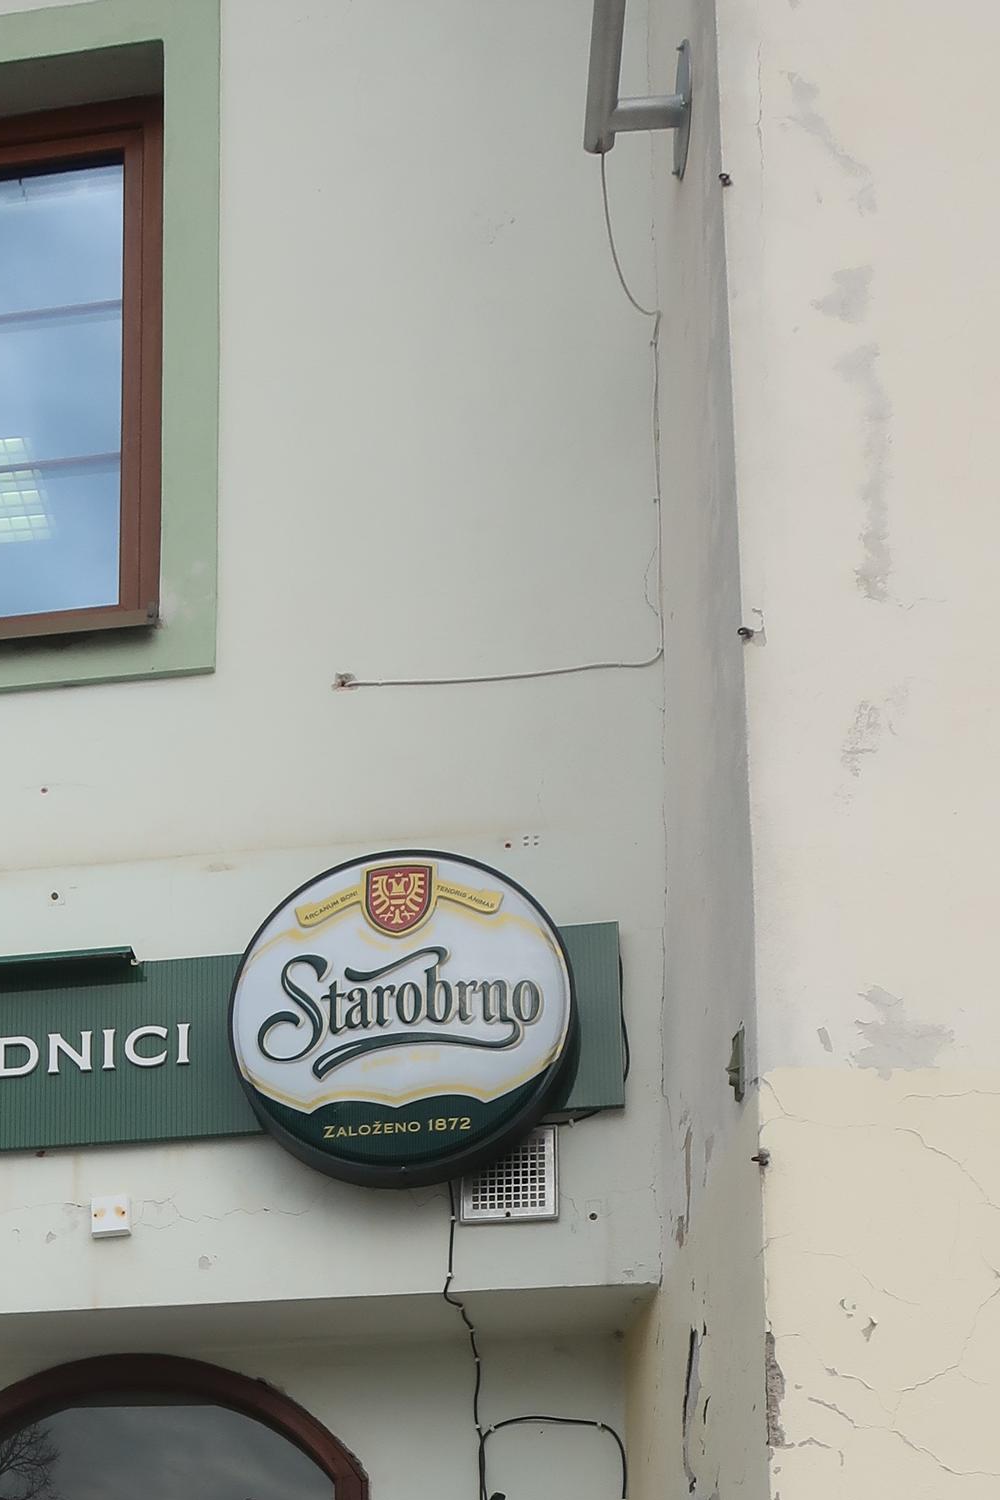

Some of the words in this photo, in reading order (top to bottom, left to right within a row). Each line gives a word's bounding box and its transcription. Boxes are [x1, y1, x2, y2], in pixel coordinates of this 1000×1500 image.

[304, 899, 339, 921] ARCANUM
[340, 890, 359, 903] BONI
[257, 945, 544, 1081] Starobrno
[323, 1120, 421, 1139] ZALOŽENO
[428, 1117, 472, 1132] 1872
